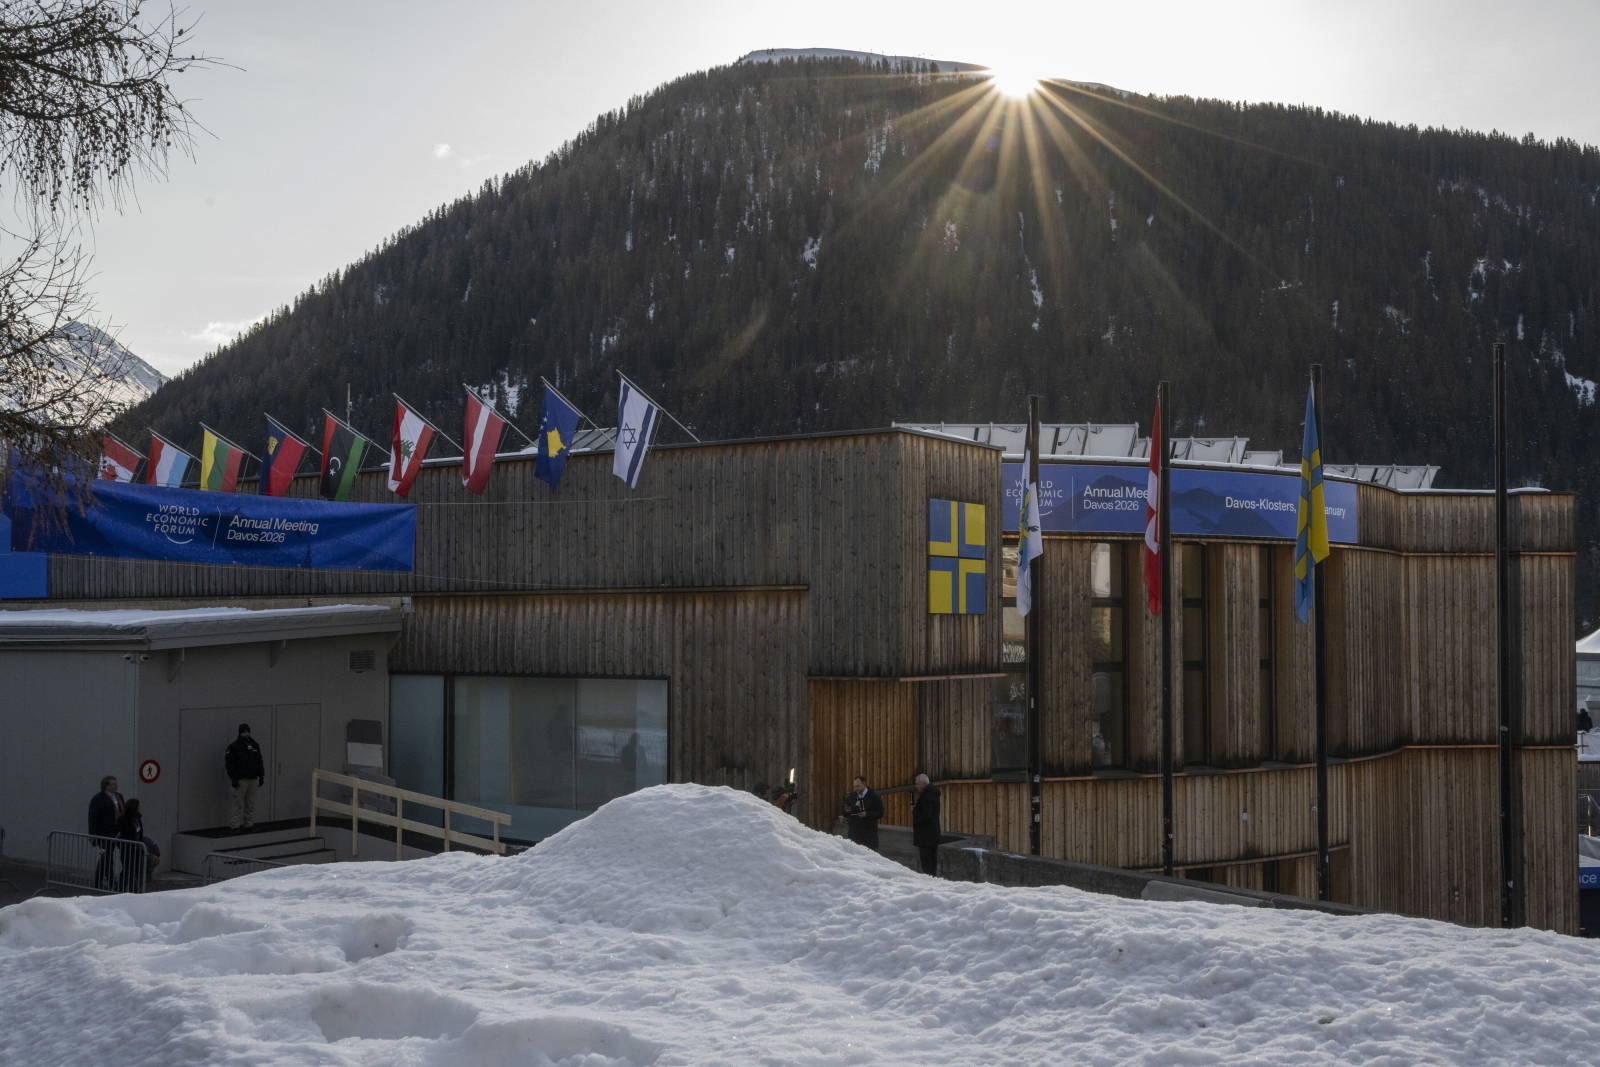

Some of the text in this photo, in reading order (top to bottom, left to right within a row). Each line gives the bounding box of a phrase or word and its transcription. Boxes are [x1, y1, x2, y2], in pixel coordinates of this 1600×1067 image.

[1015, 480, 1053, 489] WLD
[1083, 485, 1149, 499] Annual Mee
[1015, 499, 1053, 507] FUM
[1083, 500, 1140, 511] Davos 2026
[1225, 496, 1346, 519] Davos-Klosters, anuary
[159, 504, 200, 516] WORLD
[145, 513, 209, 527] ECONOMIC
[229, 514, 320, 535] Annual Meeting
[154, 523, 195, 535] FORUM
[227, 529, 286, 543] Davos 2026
